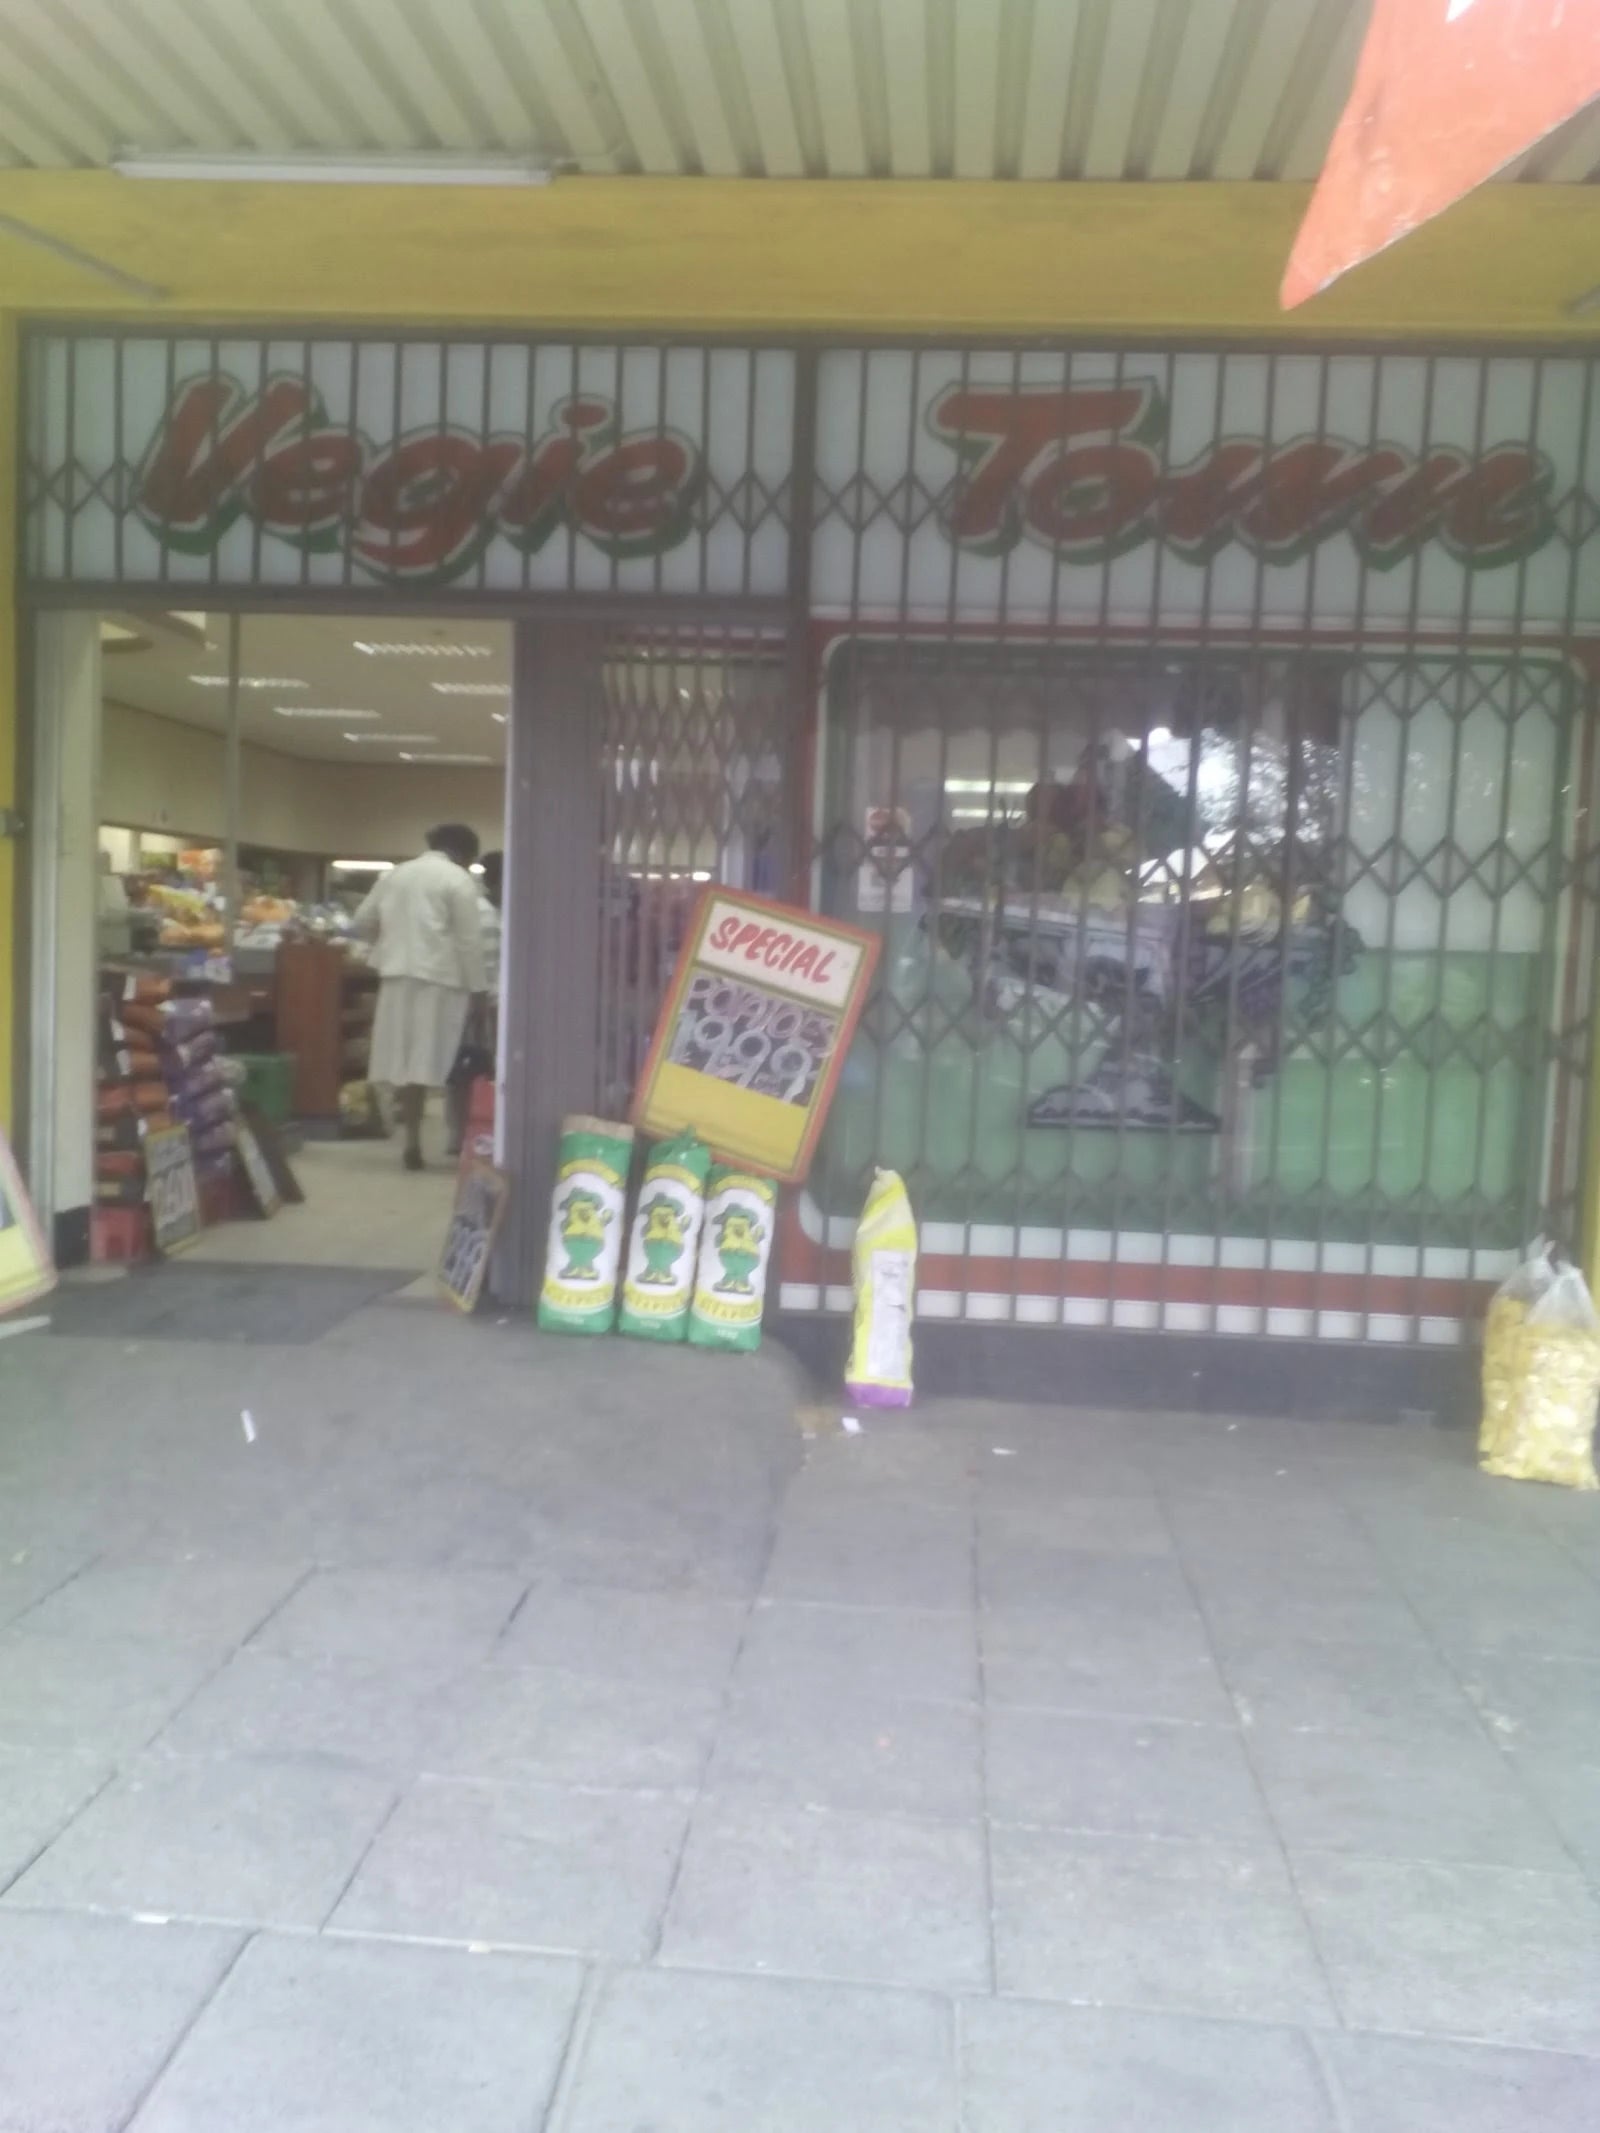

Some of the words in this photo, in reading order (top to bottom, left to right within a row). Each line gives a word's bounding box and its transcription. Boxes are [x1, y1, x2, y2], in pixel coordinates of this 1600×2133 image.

[136, 374, 693, 578] Vegie
[930, 379, 1546, 564] Town
[709, 916, 837, 984] SPECIAL
